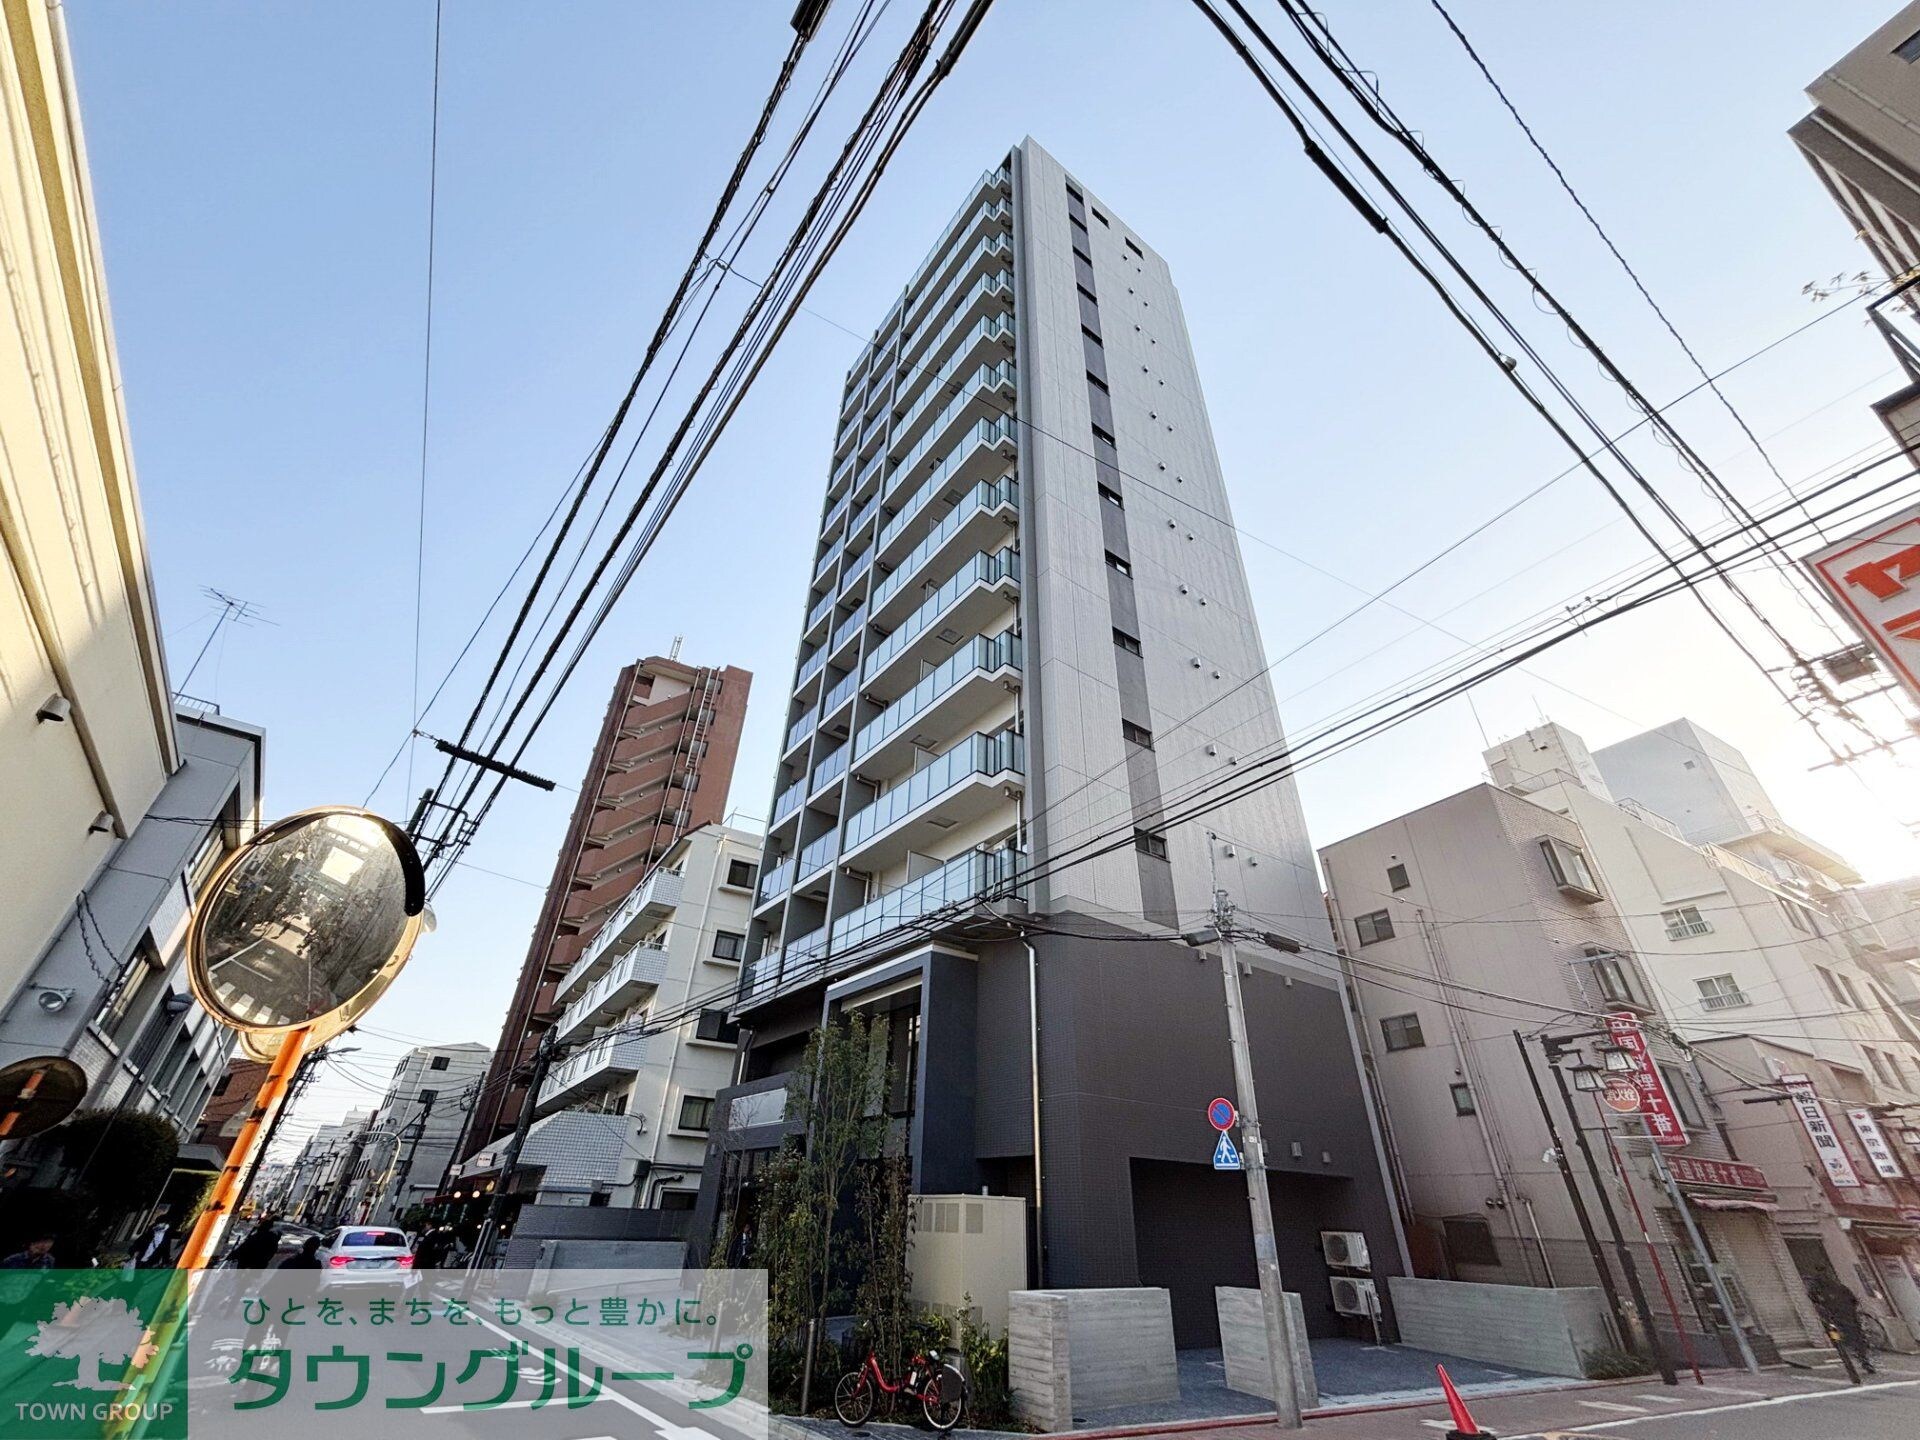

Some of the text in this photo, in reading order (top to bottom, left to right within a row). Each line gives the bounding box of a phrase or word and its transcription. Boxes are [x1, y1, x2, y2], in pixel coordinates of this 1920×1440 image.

[1605, 1088, 1637, 1101] 消火栓
[1793, 1091, 1836, 1148] 朝日新聞
